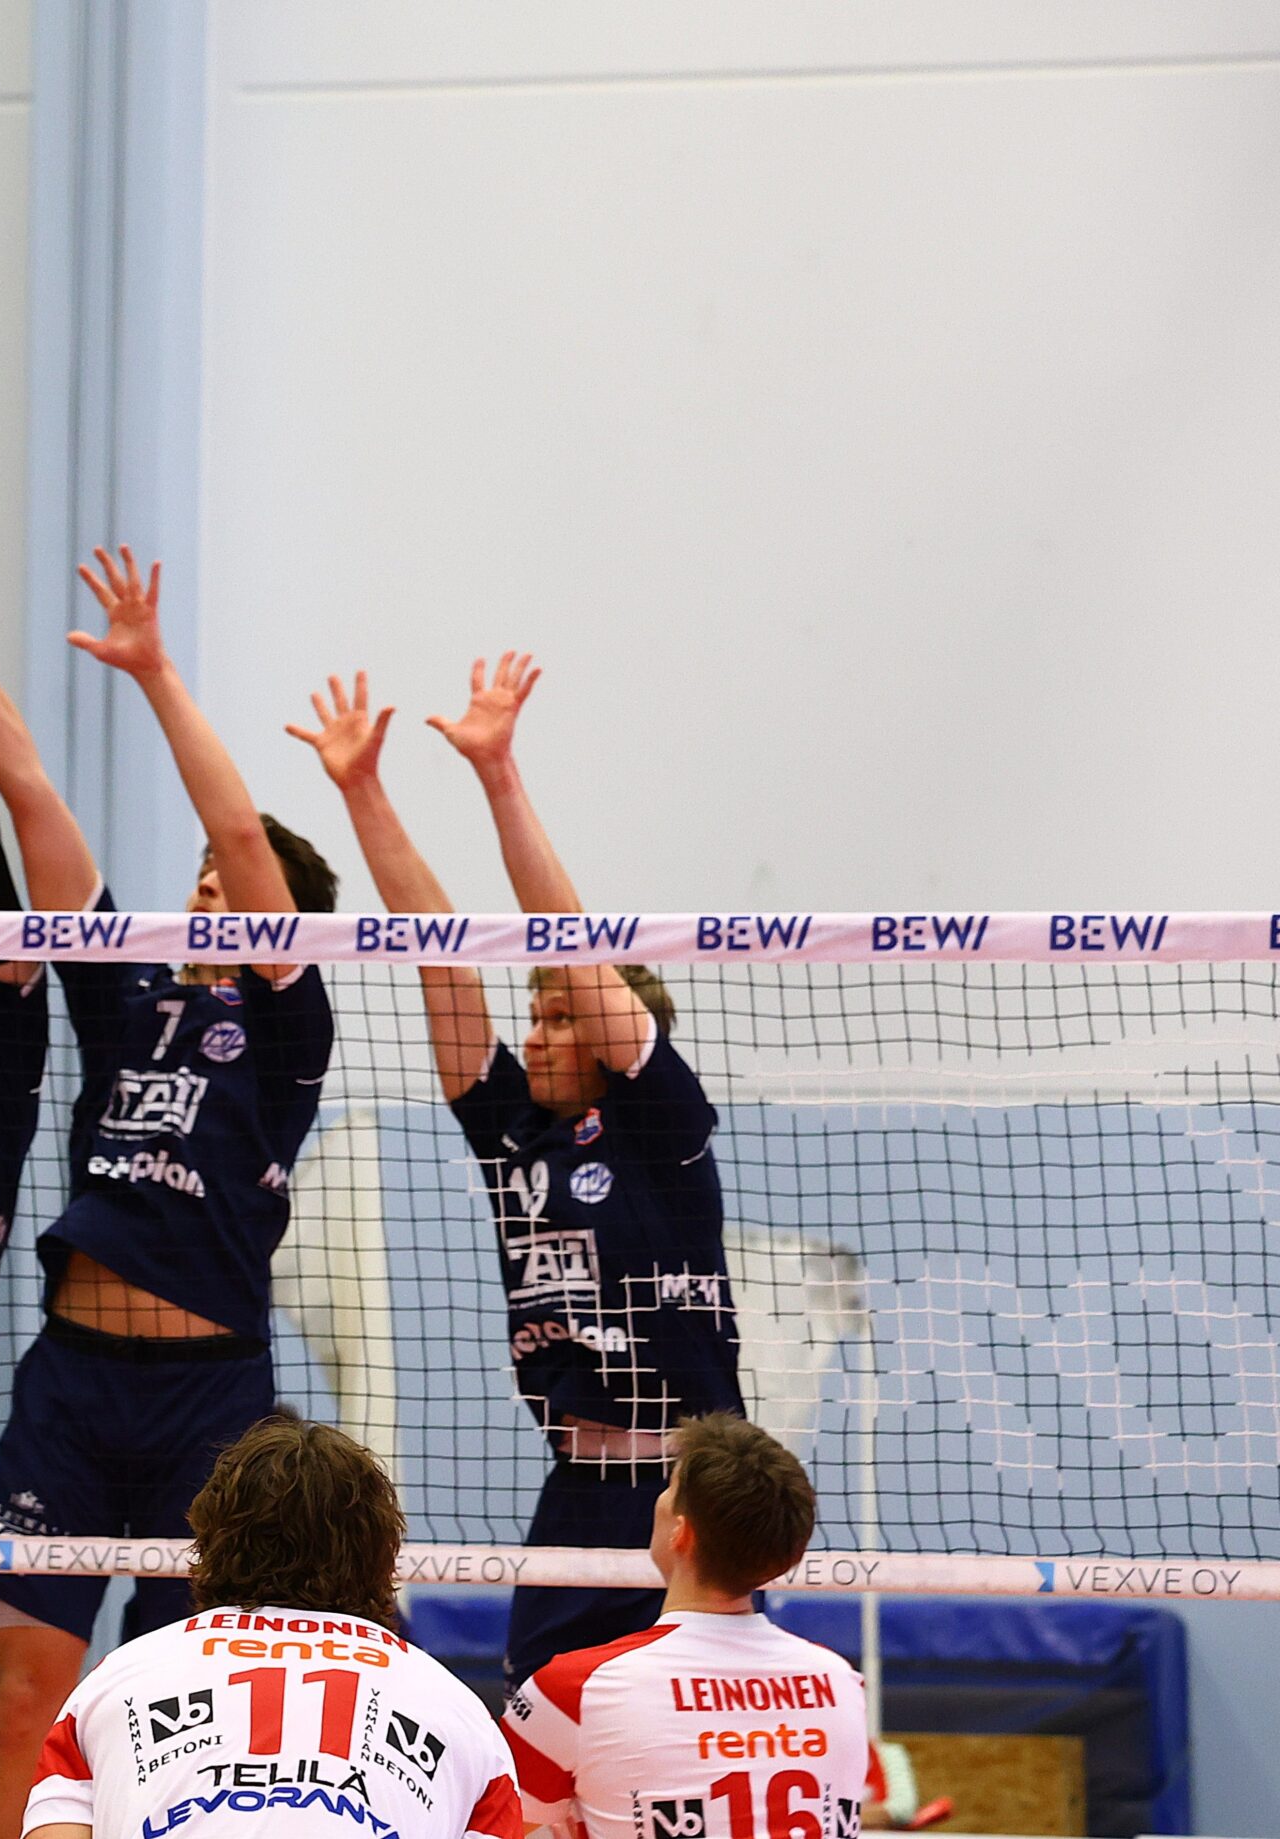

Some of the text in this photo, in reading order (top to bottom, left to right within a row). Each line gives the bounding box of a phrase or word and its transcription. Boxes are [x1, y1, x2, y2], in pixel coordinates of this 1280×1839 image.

[151, 1000, 186, 1060] 7
[509, 1160, 550, 1218] 19
[24, 1543, 186, 1574] VEXVE OY
[393, 1555, 528, 1583] XVE OY
[832, 1559, 880, 1586] OY
[1066, 1566, 1241, 1596] VEXVE OY
[184, 1614, 409, 1653] LEINONEN
[201, 1637, 390, 1668] renta
[671, 1673, 837, 1712] LEINONEN
[228, 1667, 360, 1760] 11
[360, 1688, 381, 1762] VAMMALAN
[124, 1697, 147, 1787] VAMMALAN
[148, 1734, 223, 1774] BETONI
[698, 1723, 828, 1759] renta
[197, 1759, 371, 1806] TELILÄ
[373, 1755, 435, 1813] BETONI
[710, 1769, 821, 1839] 16
